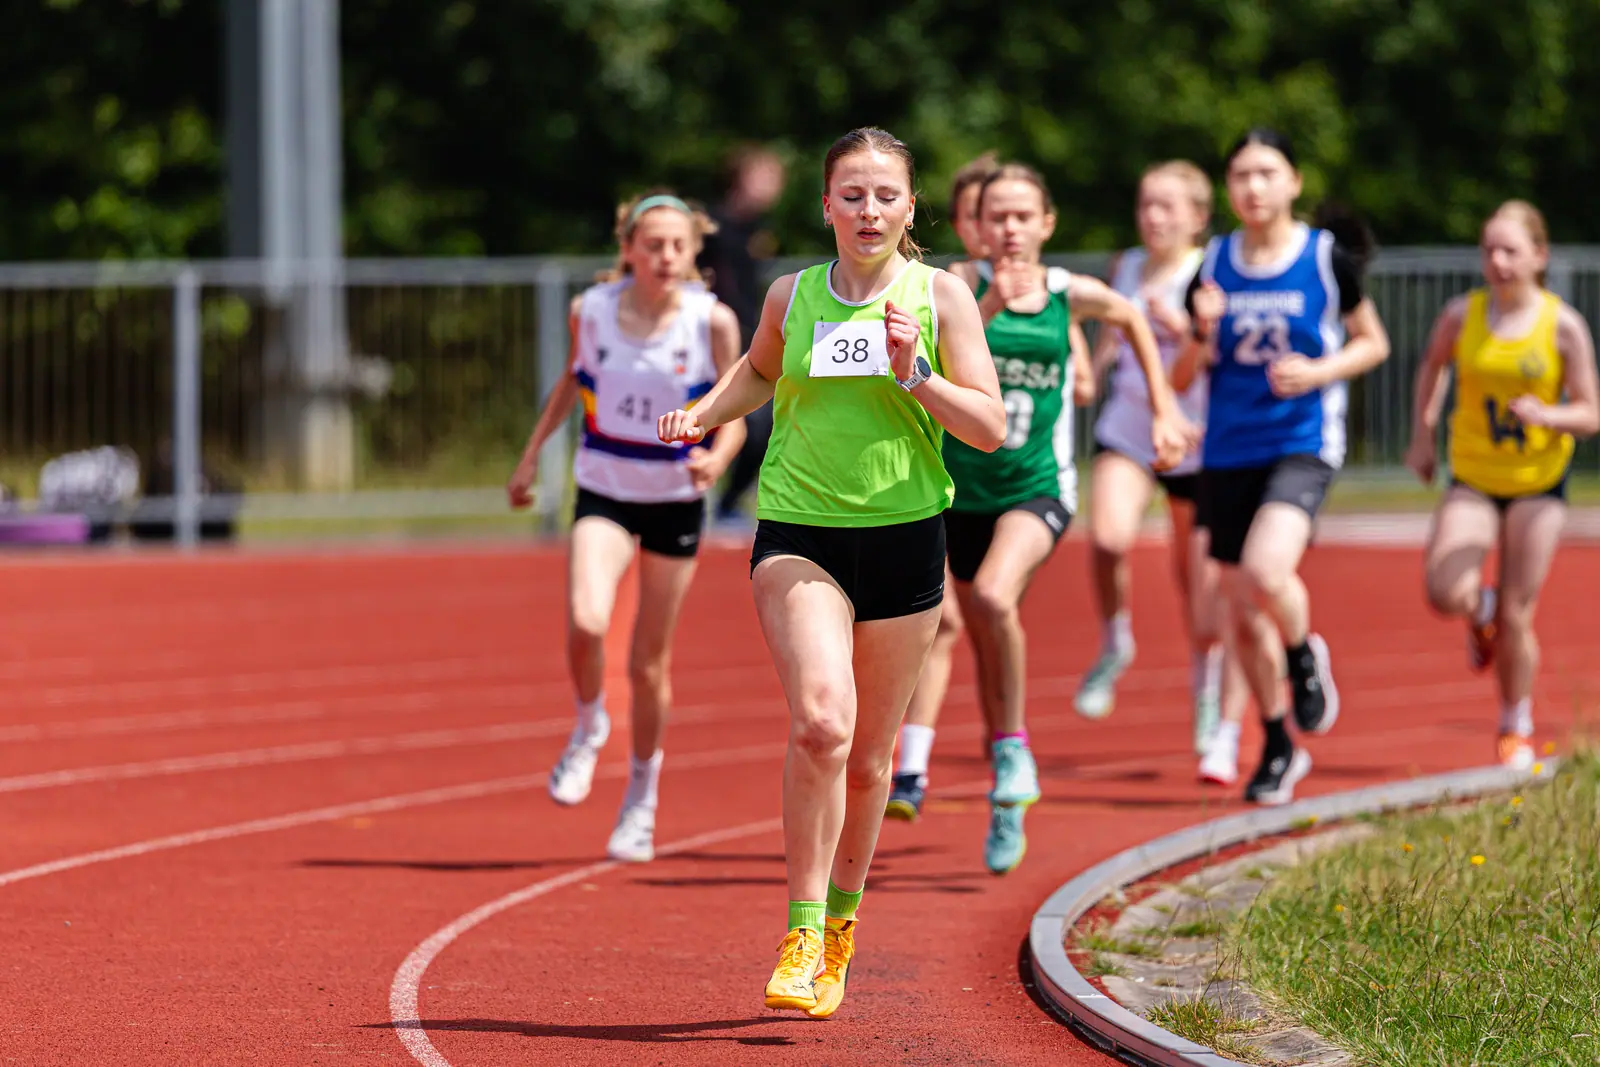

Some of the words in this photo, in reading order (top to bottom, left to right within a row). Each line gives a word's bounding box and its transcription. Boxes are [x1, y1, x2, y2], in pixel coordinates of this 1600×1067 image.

[831, 338, 869, 363] 38
[1232, 314, 1291, 366] 23
[617, 394, 652, 423] 41
